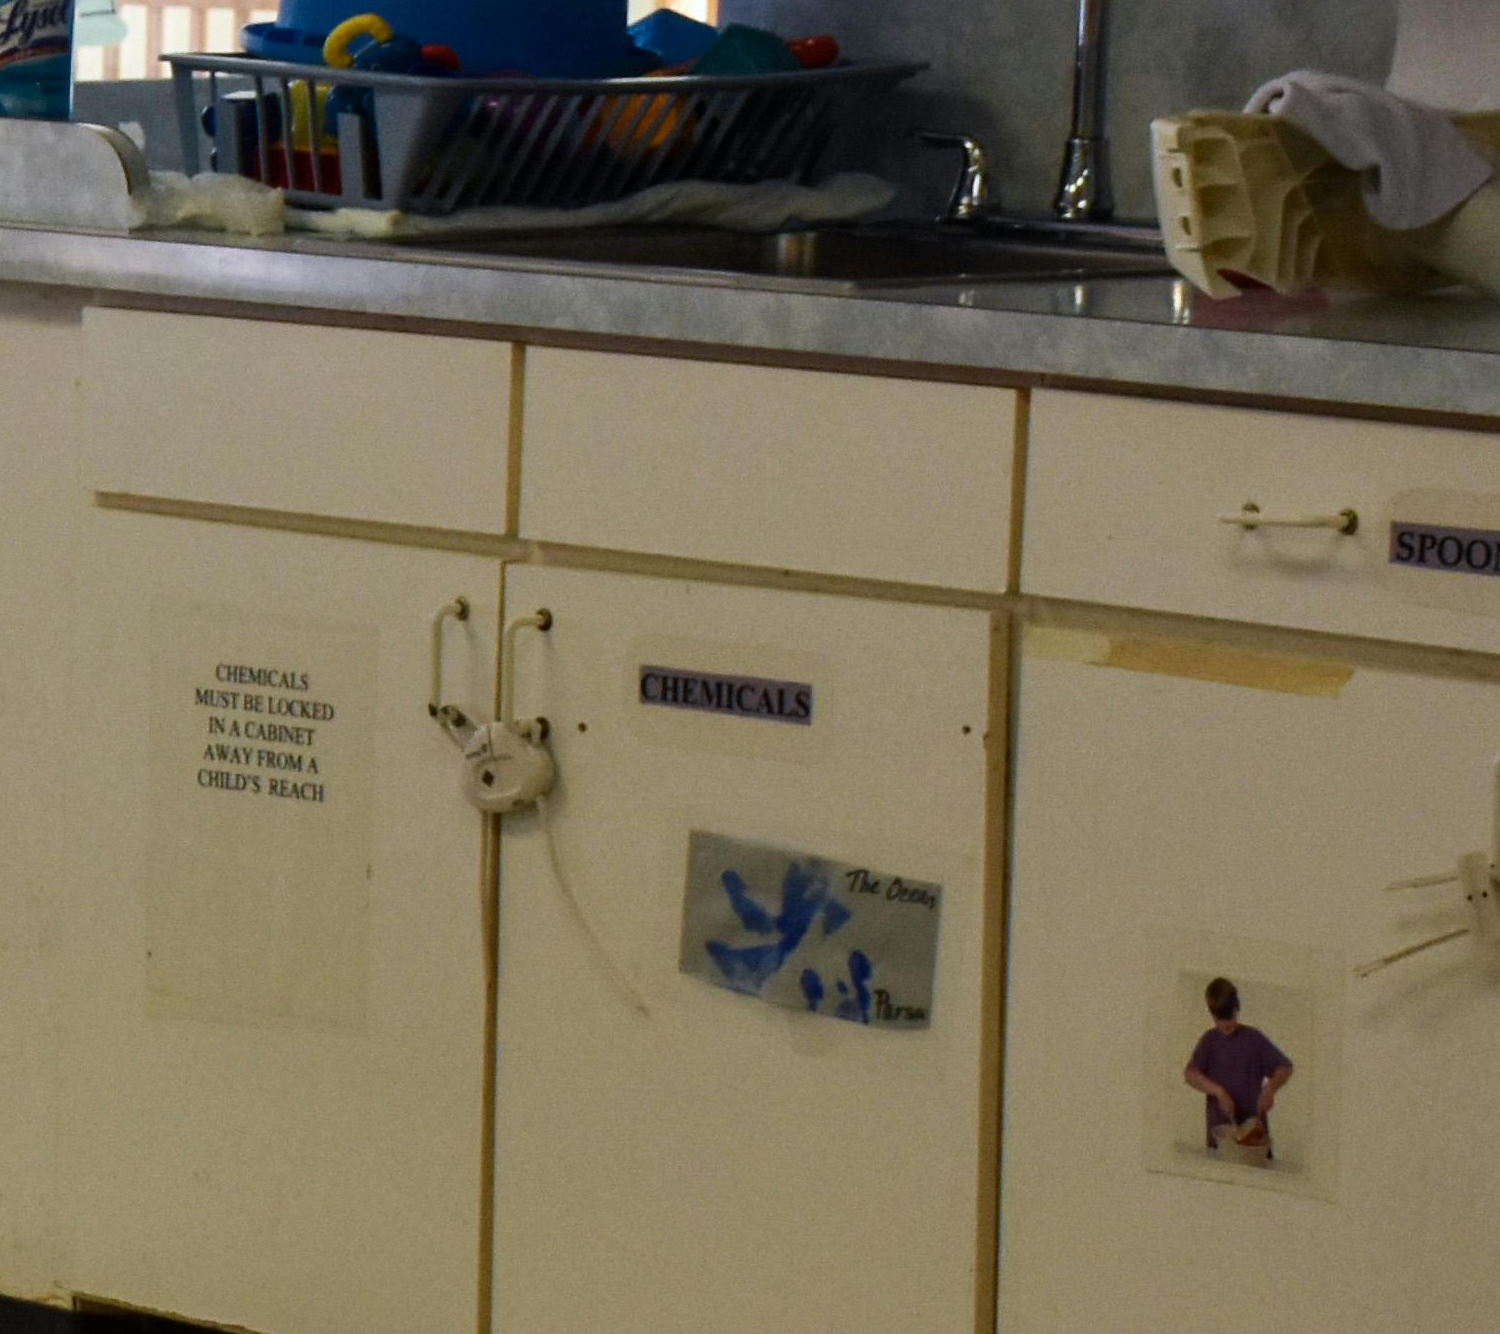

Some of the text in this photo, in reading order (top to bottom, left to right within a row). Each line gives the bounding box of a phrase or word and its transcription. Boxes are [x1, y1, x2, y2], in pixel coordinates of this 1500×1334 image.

[215, 664, 309, 691] CHEMICALS
[195, 687, 334, 722] MUST BE LOCKED
[639, 672, 811, 719] CHEMICALS
[209, 716, 315, 746] IN A CABINET
[203, 744, 319, 775] AWAY FROM A
[197, 769, 325, 803] CHILD'S REACH
[845, 869, 881, 895] The
